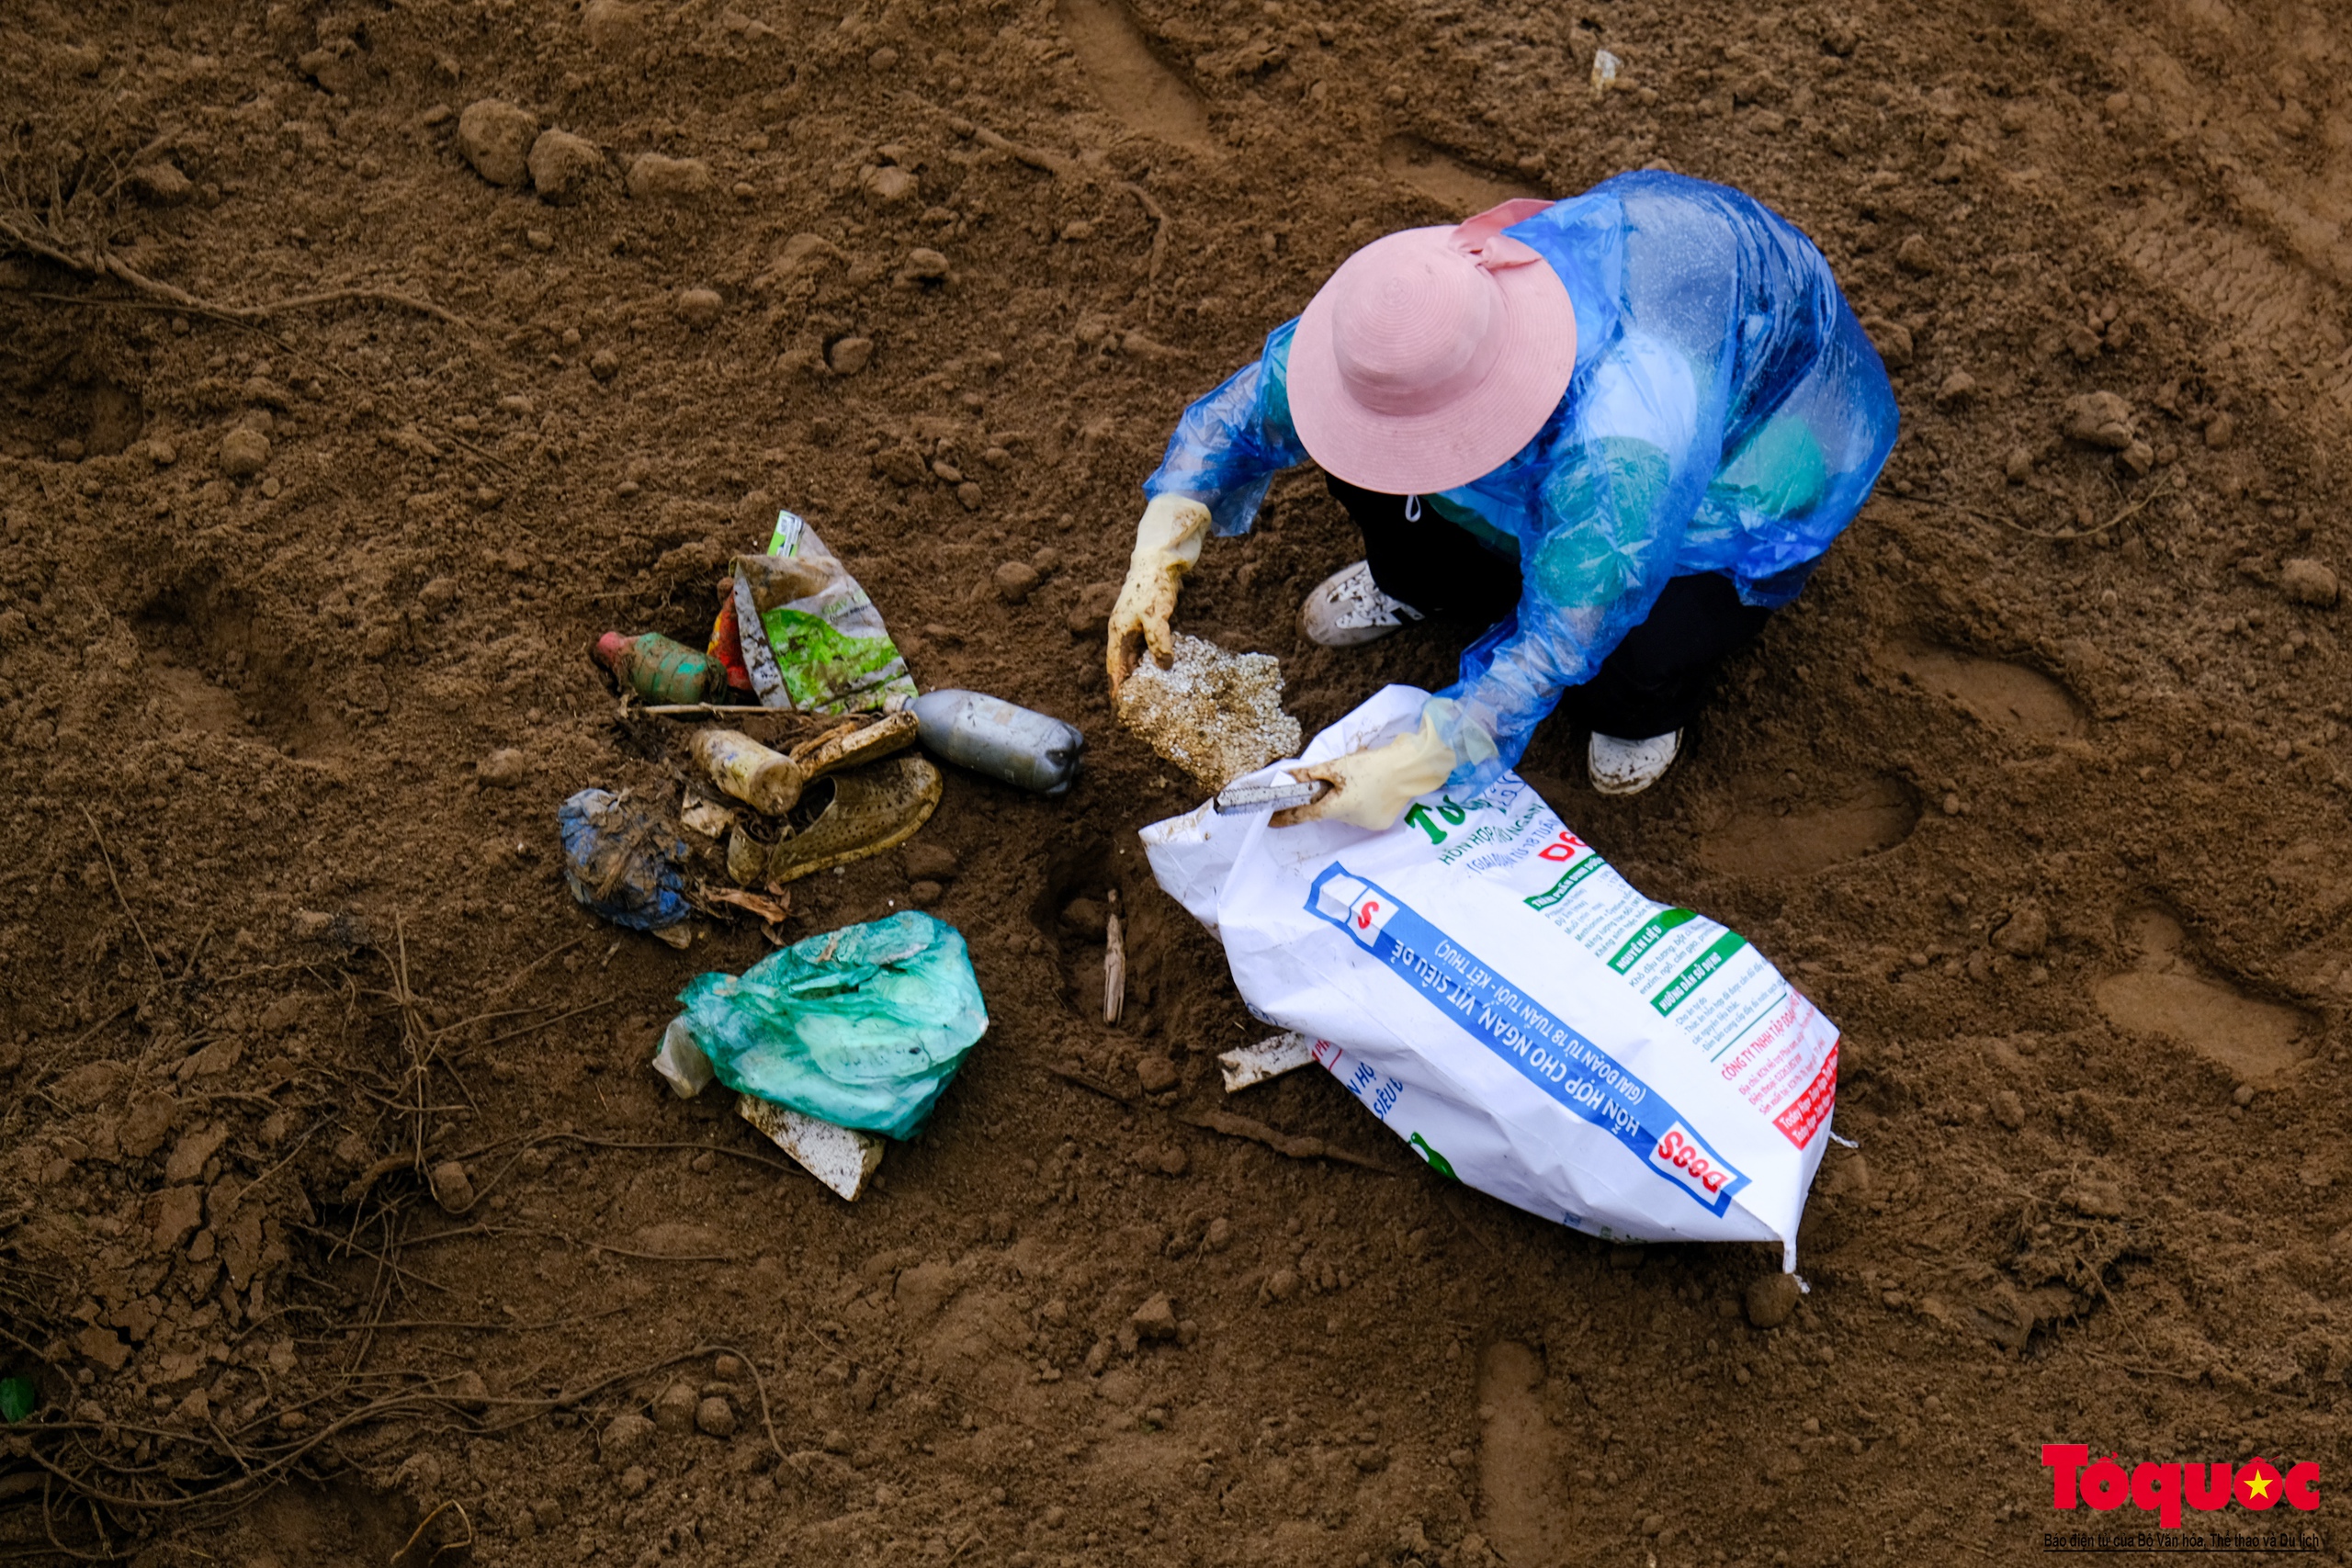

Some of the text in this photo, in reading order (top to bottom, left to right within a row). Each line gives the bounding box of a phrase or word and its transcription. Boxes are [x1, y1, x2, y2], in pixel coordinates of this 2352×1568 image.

[1435, 939, 1471, 973] THÚC)
[1616, 923, 1662, 970] NGUYÊN LIỆU
[1465, 965, 1491, 988] KẾT
[1491, 985, 1522, 1012] TUỔI
[1519, 1003, 1554, 1035] TUẦN
[1389, 939, 1640, 1136] HỖN HỢP CHO NGAN, VỊT SIÊU ĐẺ
[1550, 1029, 1567, 1047] 18
[1563, 1038, 1583, 1058] TỪ
[1580, 1050, 1619, 1085] ĐOẠN
[1721, 1056, 1747, 1080] CÔNG
[1740, 1047, 1757, 1062] TY
[1749, 1031, 1775, 1054] TNHH
[1373, 1083, 1397, 1120] SIÊU
[1613, 1075, 1645, 1104] (GIAI
[1778, 1108, 1802, 1129] Today
